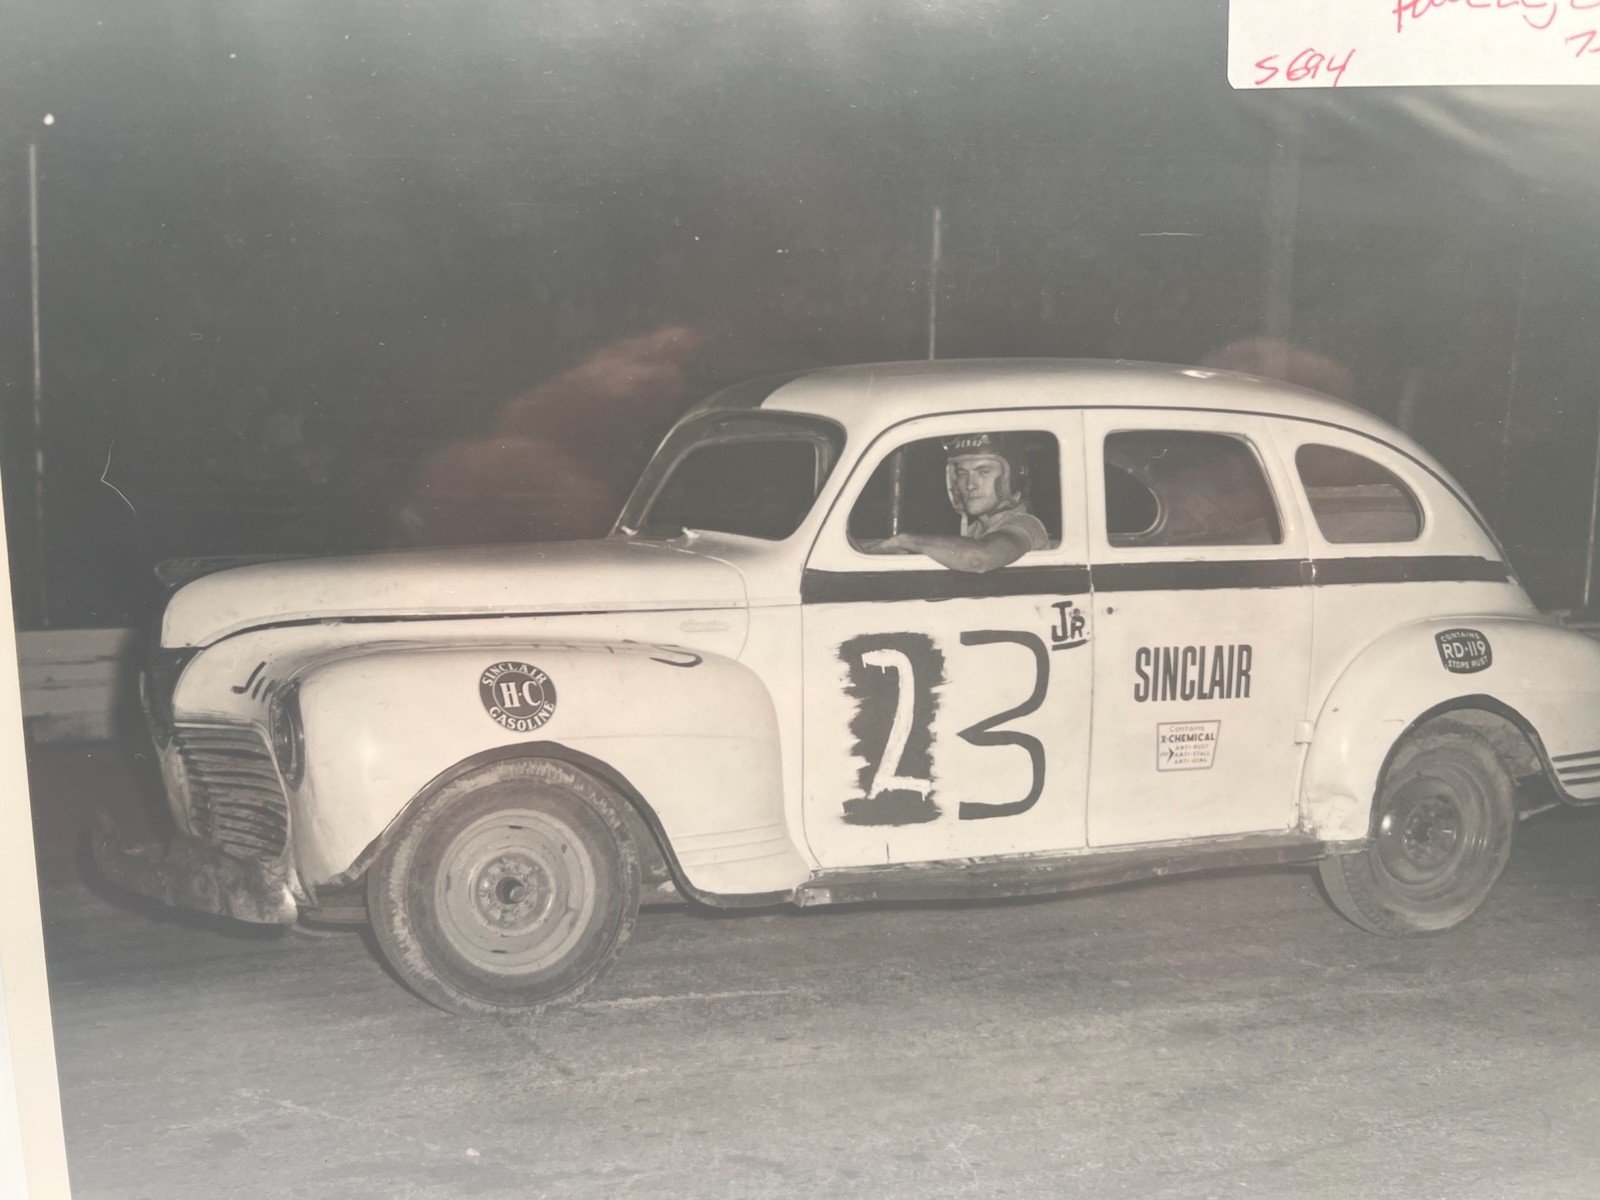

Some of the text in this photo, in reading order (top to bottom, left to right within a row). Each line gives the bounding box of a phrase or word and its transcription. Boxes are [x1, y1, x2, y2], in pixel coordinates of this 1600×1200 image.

[481, 662, 547, 687] SINCLAIR
[1133, 644, 1253, 703] SINCLAIR
[488, 700, 555, 731] GASOLINE
[858, 629, 1051, 821] 23
